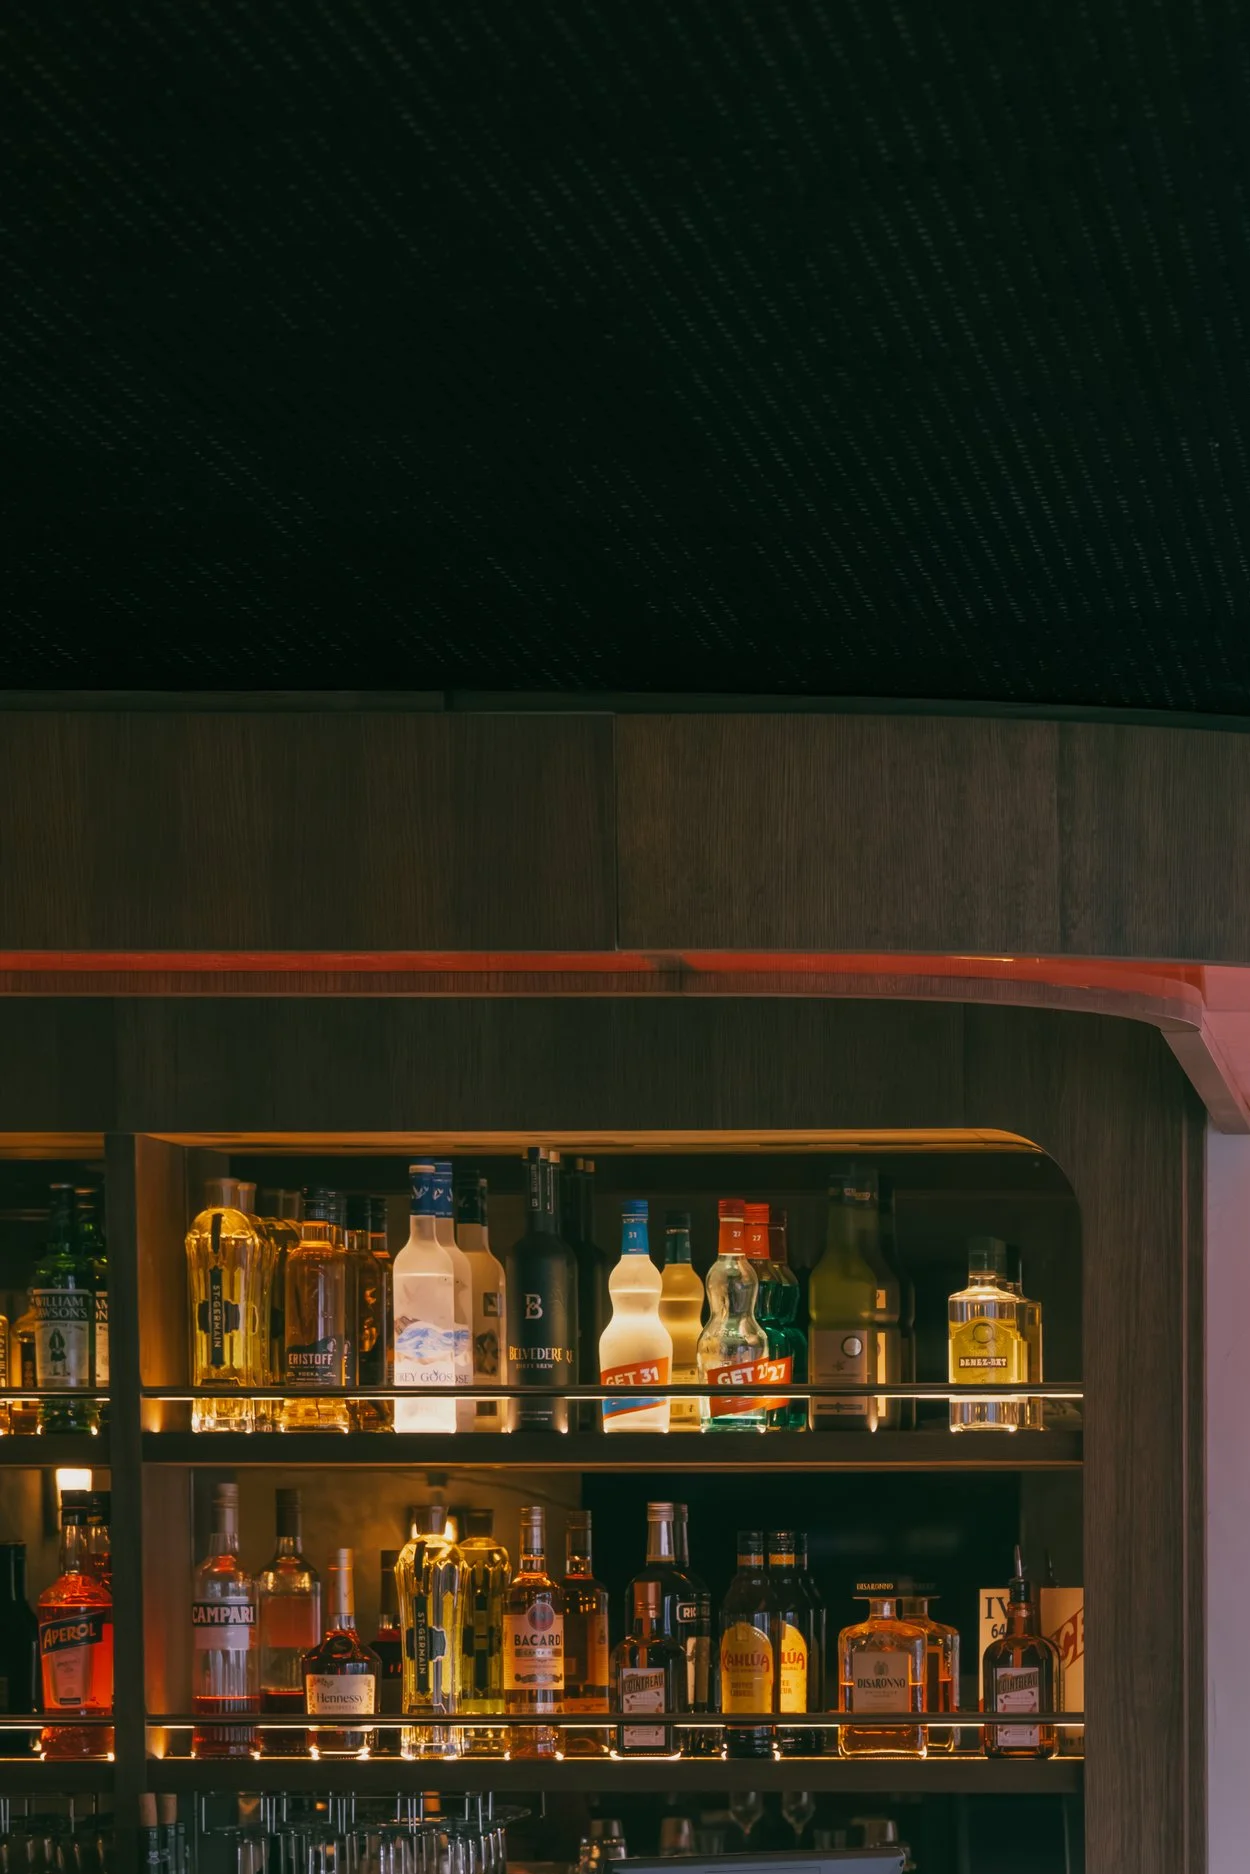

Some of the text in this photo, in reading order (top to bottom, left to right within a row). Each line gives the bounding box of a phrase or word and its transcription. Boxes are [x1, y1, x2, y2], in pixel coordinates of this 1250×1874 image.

[35, 1295, 85, 1307] WILLIAM
[288, 1353, 333, 1365] ERISTOFF
[509, 1345, 563, 1362] BELVEDERE
[606, 1366, 659, 1385] GET 31
[717, 1367, 754, 1385] GET
[768, 1363, 786, 1381] 27
[192, 1605, 256, 1624] CAMPARI
[44, 1622, 97, 1650] APEROL
[722, 1650, 770, 1672] KAHLÚA
[857, 1678, 906, 1688] DISARONNO
[316, 1692, 364, 1705] Hennessy
